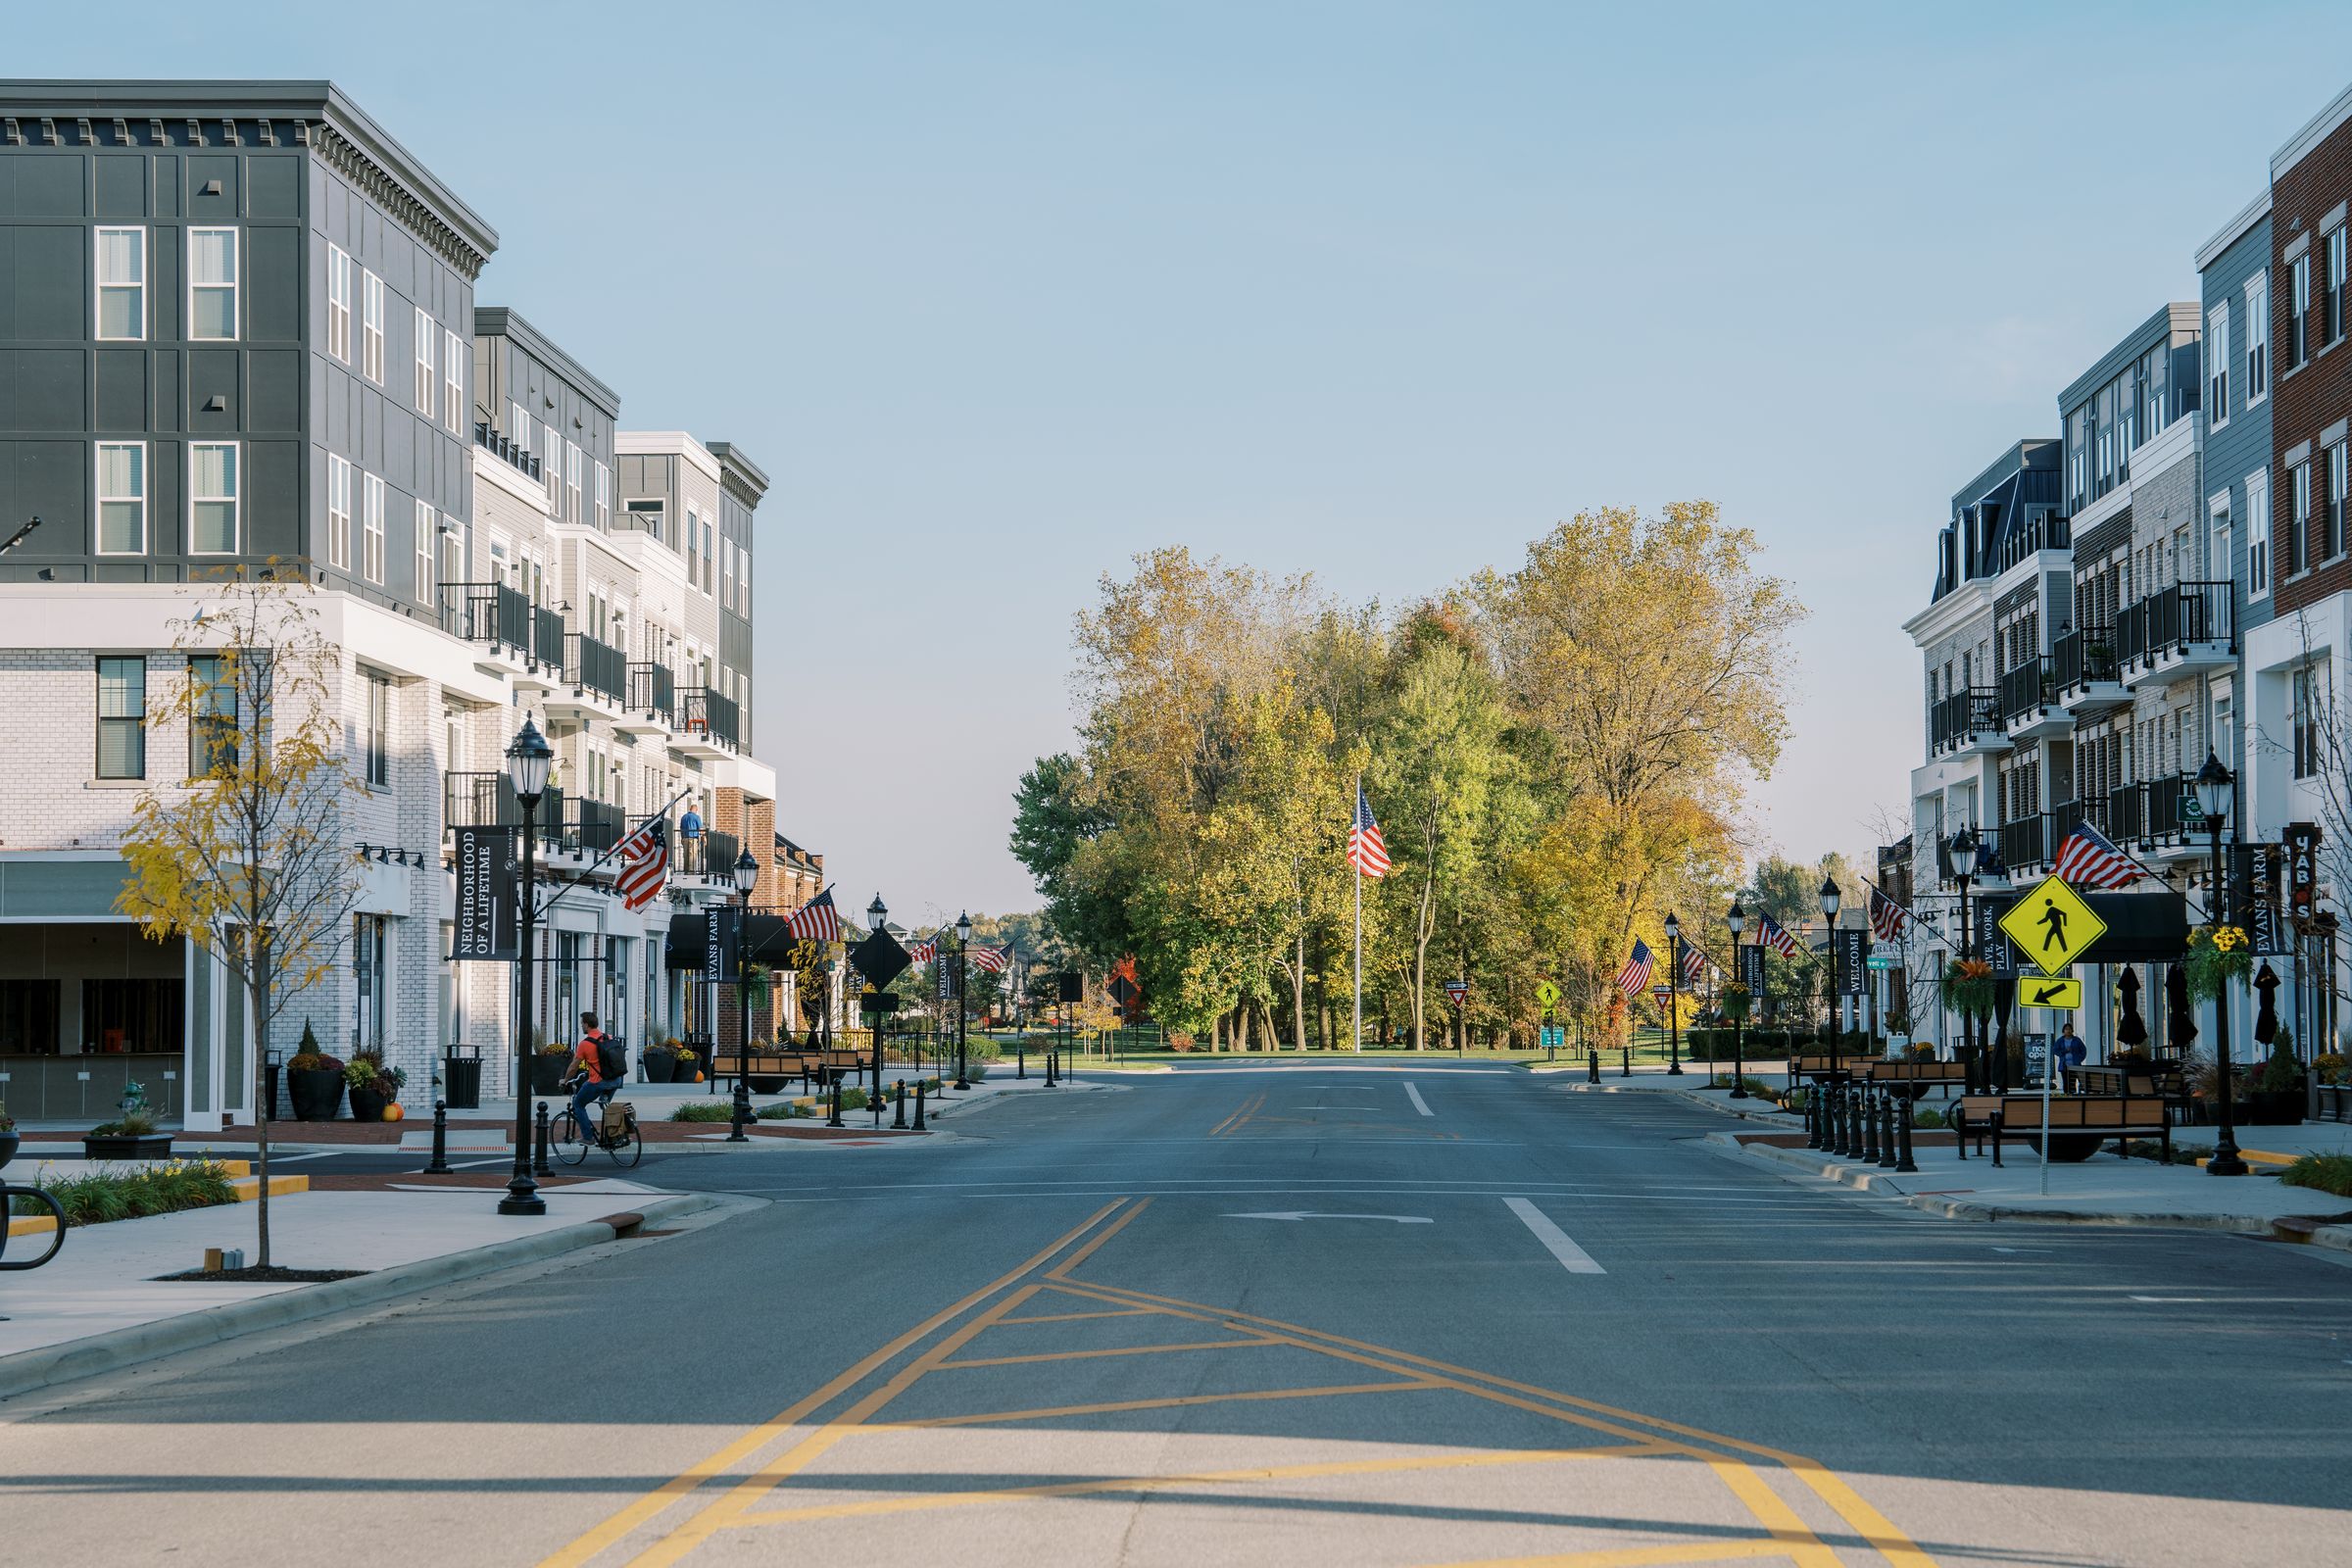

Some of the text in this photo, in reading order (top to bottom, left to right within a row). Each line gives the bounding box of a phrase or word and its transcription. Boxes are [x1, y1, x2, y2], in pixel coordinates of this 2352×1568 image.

[461, 832, 475, 954] NEIGHBORHOOD
[477, 846, 490, 954] OF A LIFETIME
[1984, 906, 1993, 940] WORK,
[2254, 848, 2270, 952] EVANS FARM
[709, 910, 718, 980] EVANS FARM
[1850, 933, 1861, 992] WELCOME
[1996, 944, 2005, 970] PLAY
